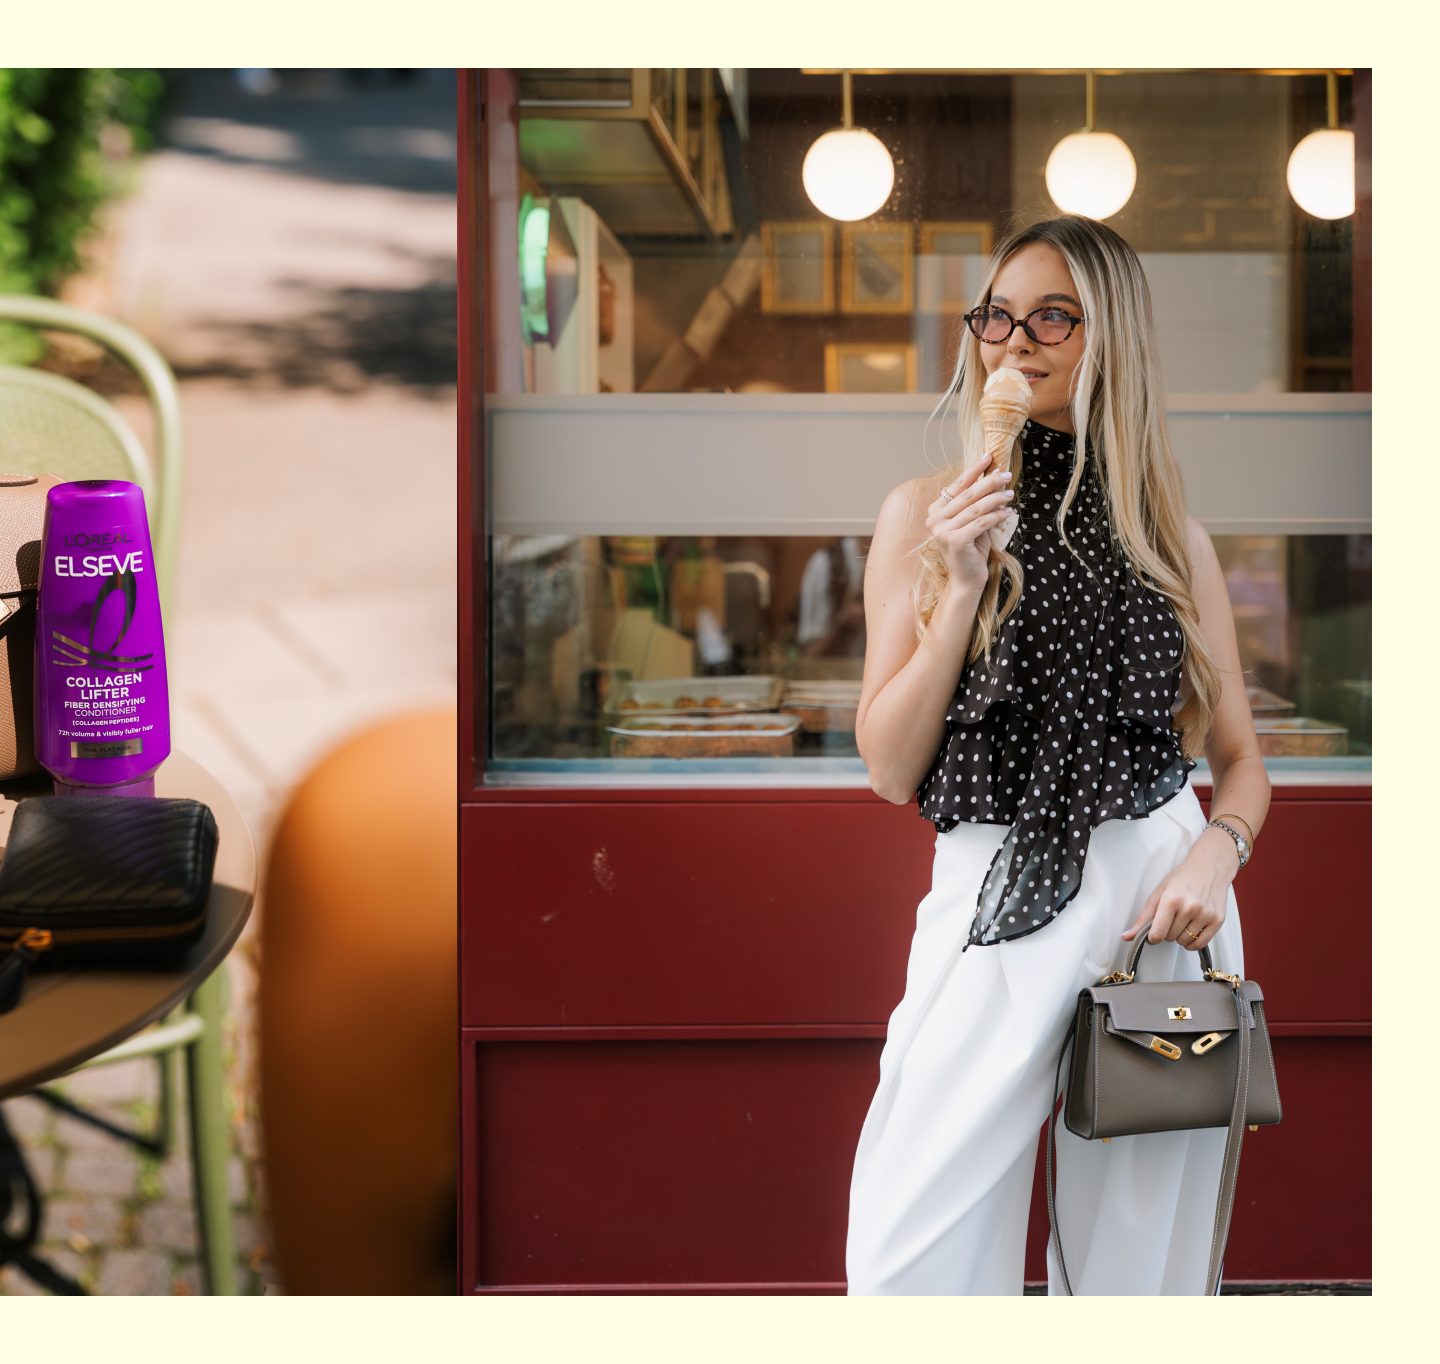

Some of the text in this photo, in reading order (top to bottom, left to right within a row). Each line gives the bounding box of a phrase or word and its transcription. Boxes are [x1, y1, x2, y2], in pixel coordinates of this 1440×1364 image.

[54, 551, 144, 577] ELSEVE
[66, 672, 142, 688] COLLAGEN
[81, 687, 130, 700] LIFTER
[64, 696, 146, 709] FIBER DENSIFYING
[74, 706, 137, 717] CONDITIONER
[103, 729, 124, 737] visibly
[142, 724, 154, 732] hair
